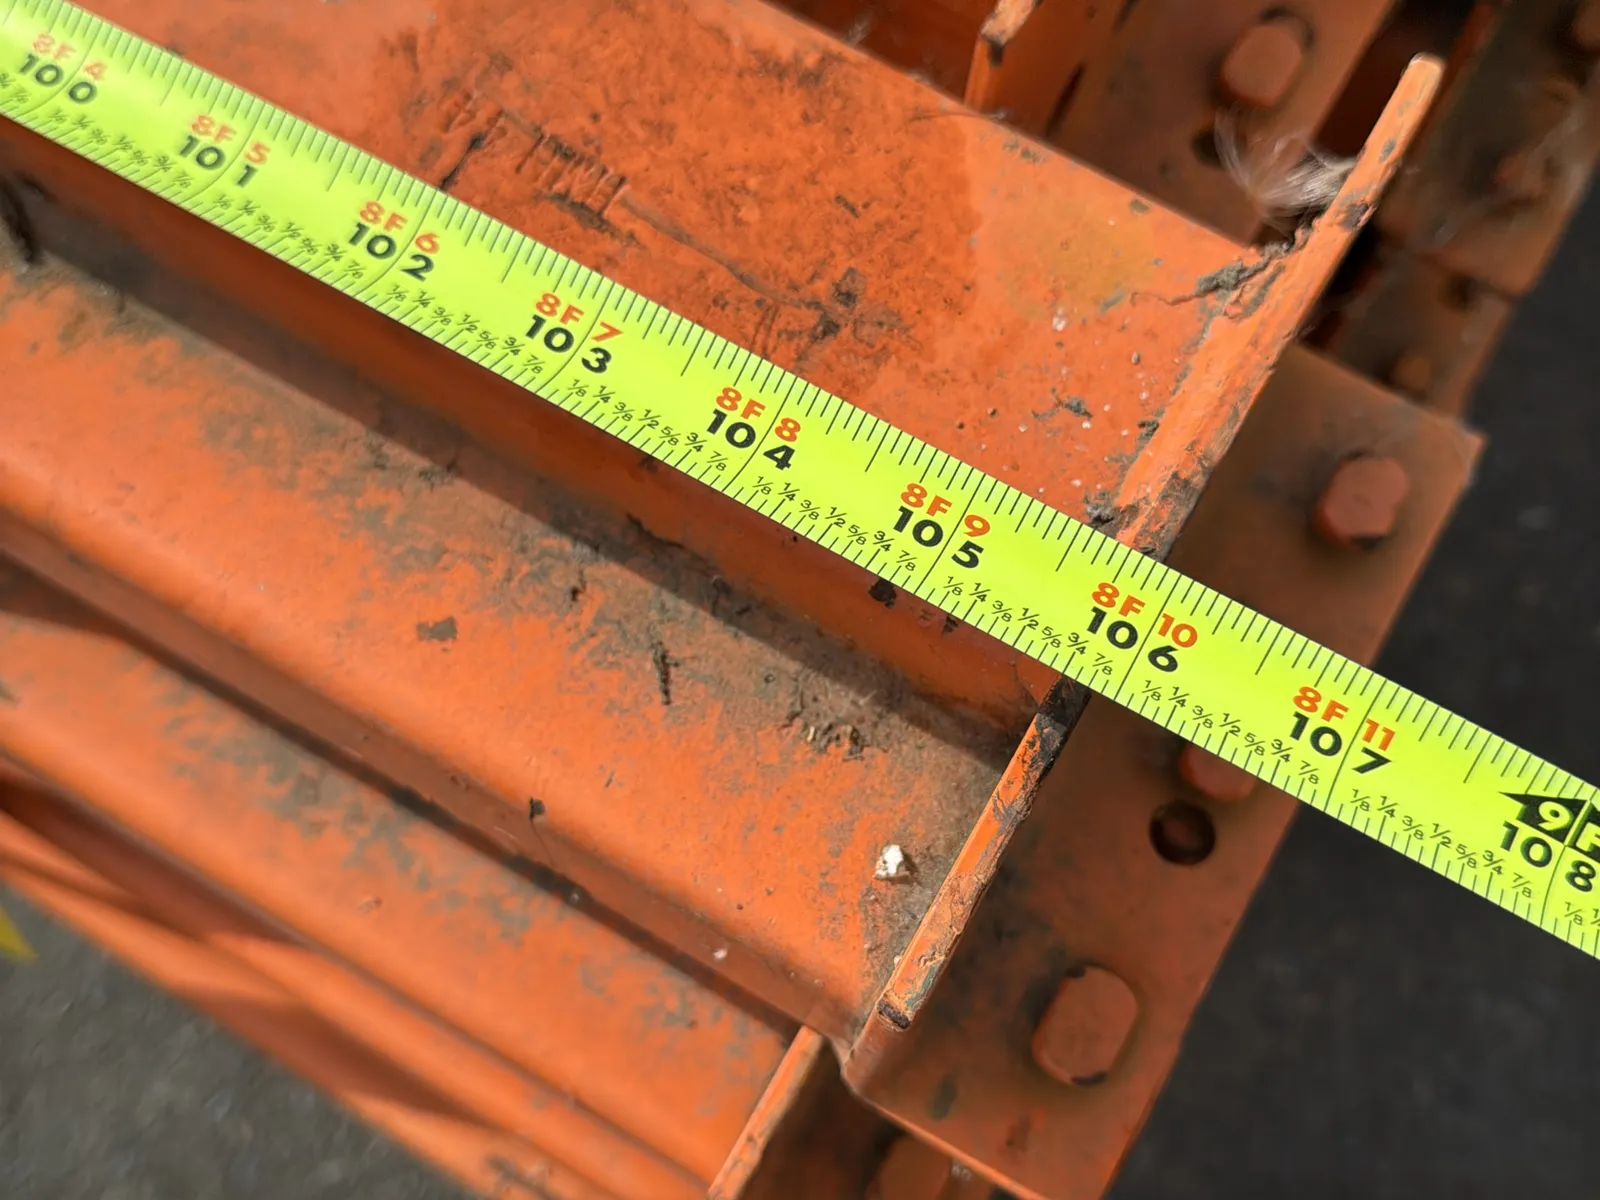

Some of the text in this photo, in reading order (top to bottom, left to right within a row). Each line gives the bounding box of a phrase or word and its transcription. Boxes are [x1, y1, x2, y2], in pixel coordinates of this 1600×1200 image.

[191, 114, 237, 143] 8F
[360, 201, 440, 254] 8F 6
[536, 293, 623, 342] 8F 7
[568, 379, 728, 471] 1/8 1/4 3/8 1/2 5/8 3/4 7/8
[716, 387, 801, 442] 8F 8
[752, 476, 918, 571] 1/8 1/4 3/8 1/2 5/8 3/4 7/8
[901, 483, 990, 537] 8F 9
[943, 576, 1113, 675] 1/8 1/4 3/8 1/2 5/8 3/4 7/8
[1092, 582, 1198, 648] 8F 10
[1142, 680, 1319, 784] 1/8 1/4 3/8 1/2 5/8 3/4 7/8
[1293, 686, 1396, 751] 8F 11
[1350, 789, 1532, 898] 1/8 1/4 3/8 1/2 5/8 3/4 7/8
[1564, 902, 1583, 926] 1/8
